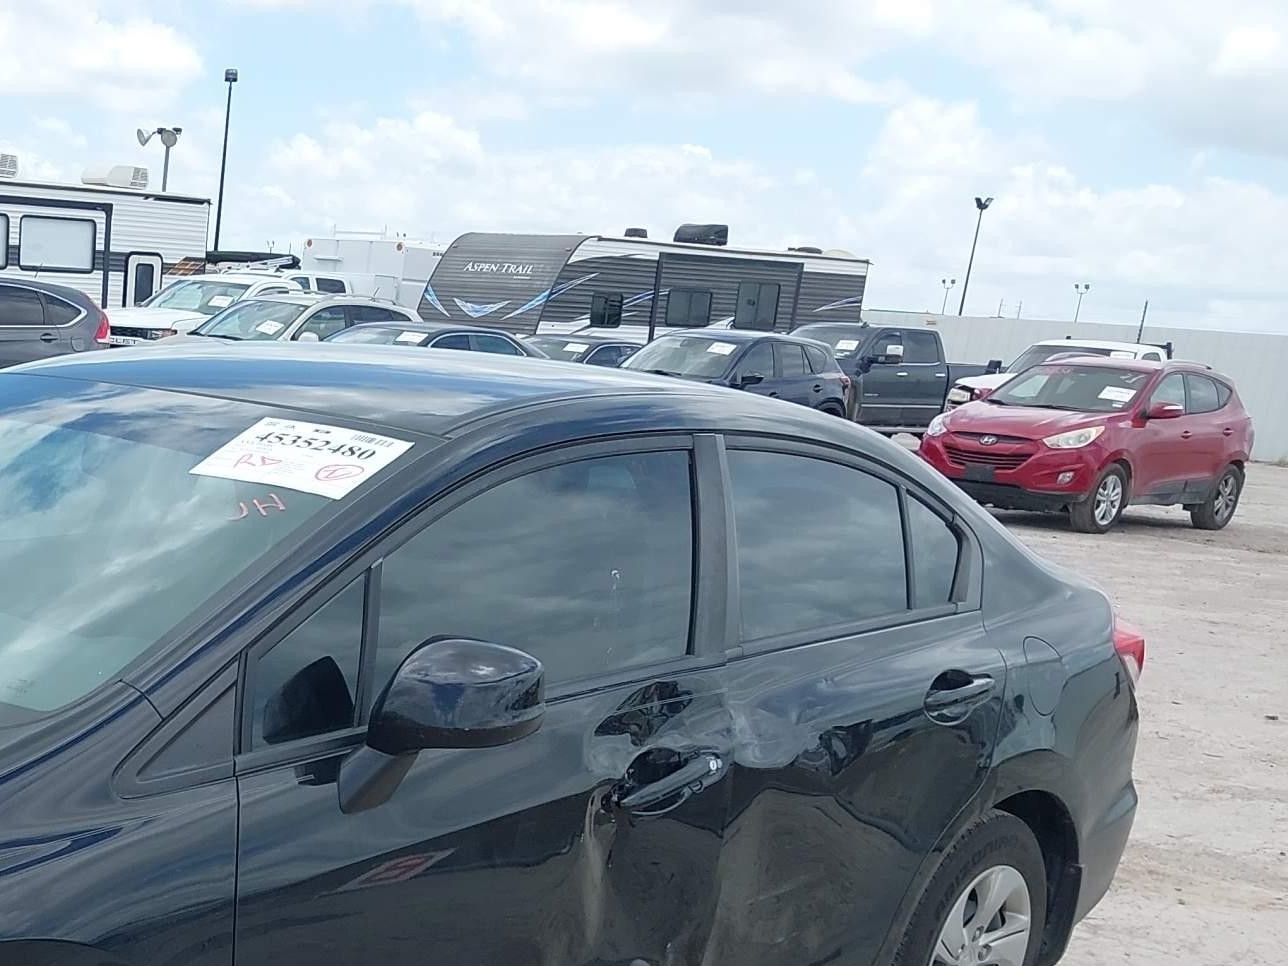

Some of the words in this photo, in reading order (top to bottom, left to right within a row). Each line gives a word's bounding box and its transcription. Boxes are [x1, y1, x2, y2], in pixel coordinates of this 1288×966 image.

[464, 261, 500, 273] ASPEN
[500, 263, 534, 274] TRAIL
[255, 431, 377, 460] 45352480
